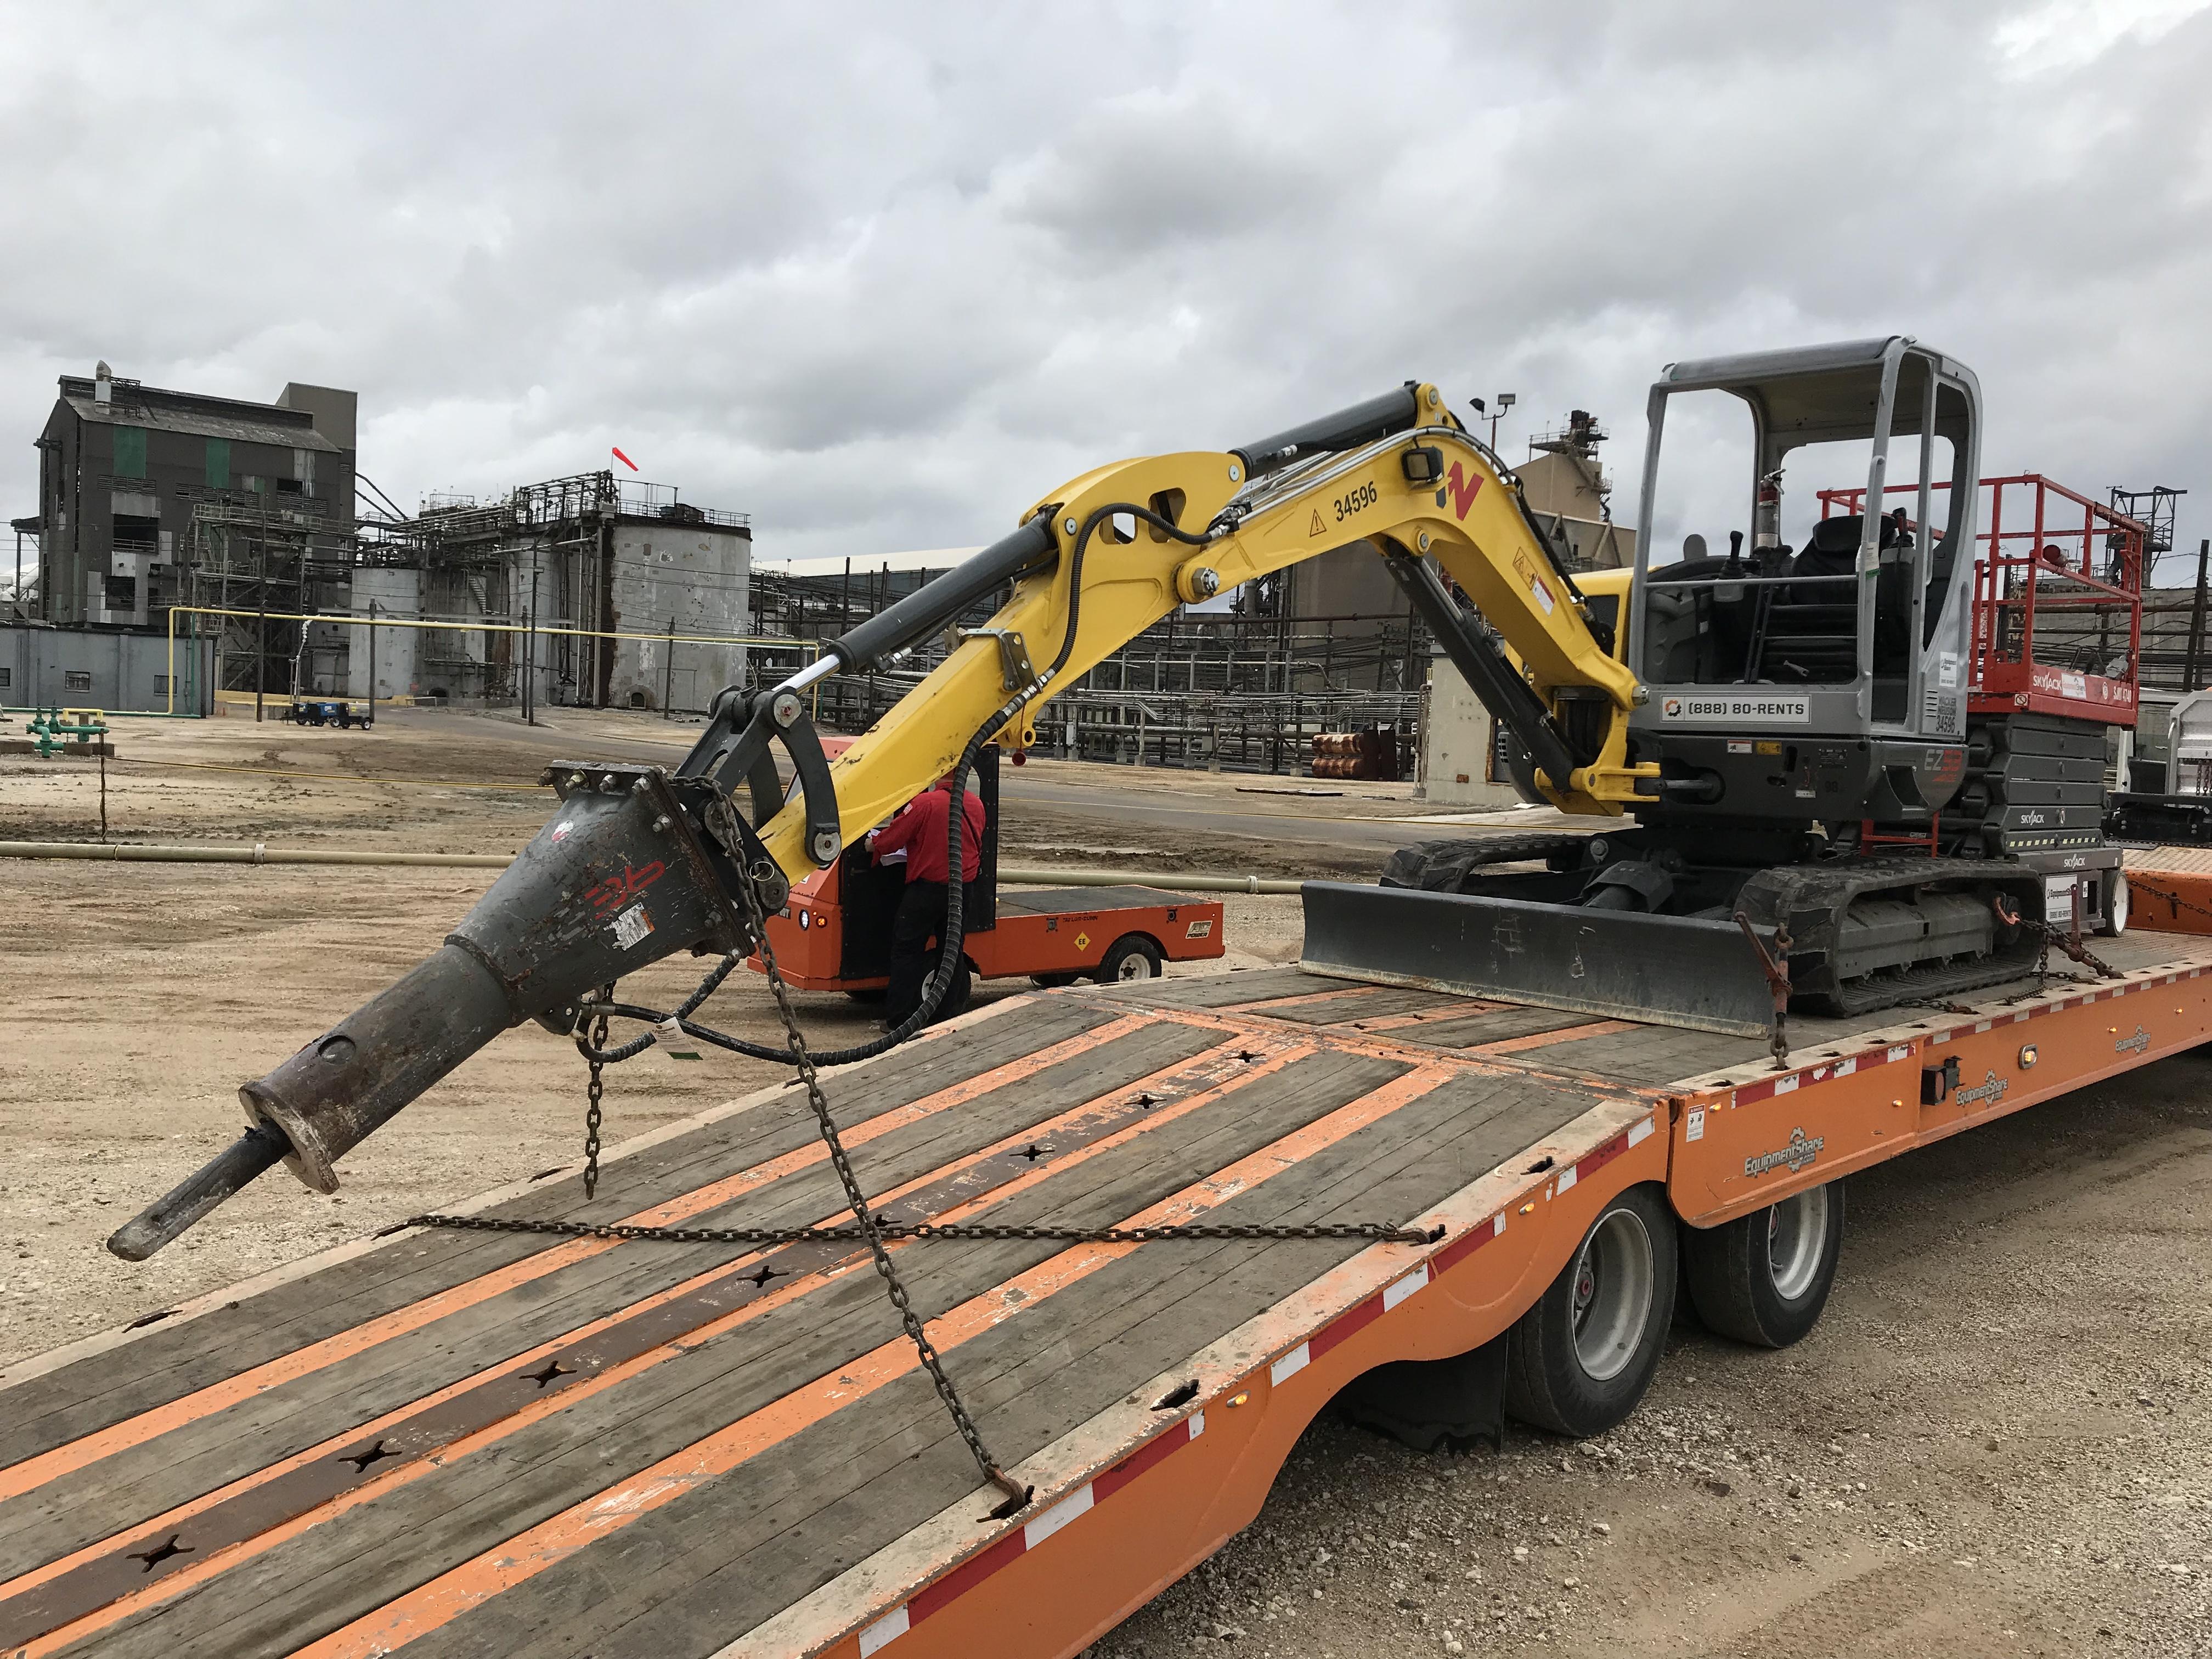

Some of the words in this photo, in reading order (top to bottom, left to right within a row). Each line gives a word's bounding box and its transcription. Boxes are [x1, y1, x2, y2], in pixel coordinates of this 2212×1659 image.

[1334, 481, 1377, 522] 34596
[2033, 672, 2062, 691] SKYJACK
[1689, 702, 1727, 715] (888)
[1732, 703, 1804, 715] 80-RENTS
[1936, 714, 1955, 733] 34596
[2021, 810, 2045, 826] SKYJACK
[2064, 853, 2085, 869] SKYJACK
[1956, 1077, 2008, 1108] EquipmentShare
[1745, 1136, 1824, 1178] EquipmentShare
